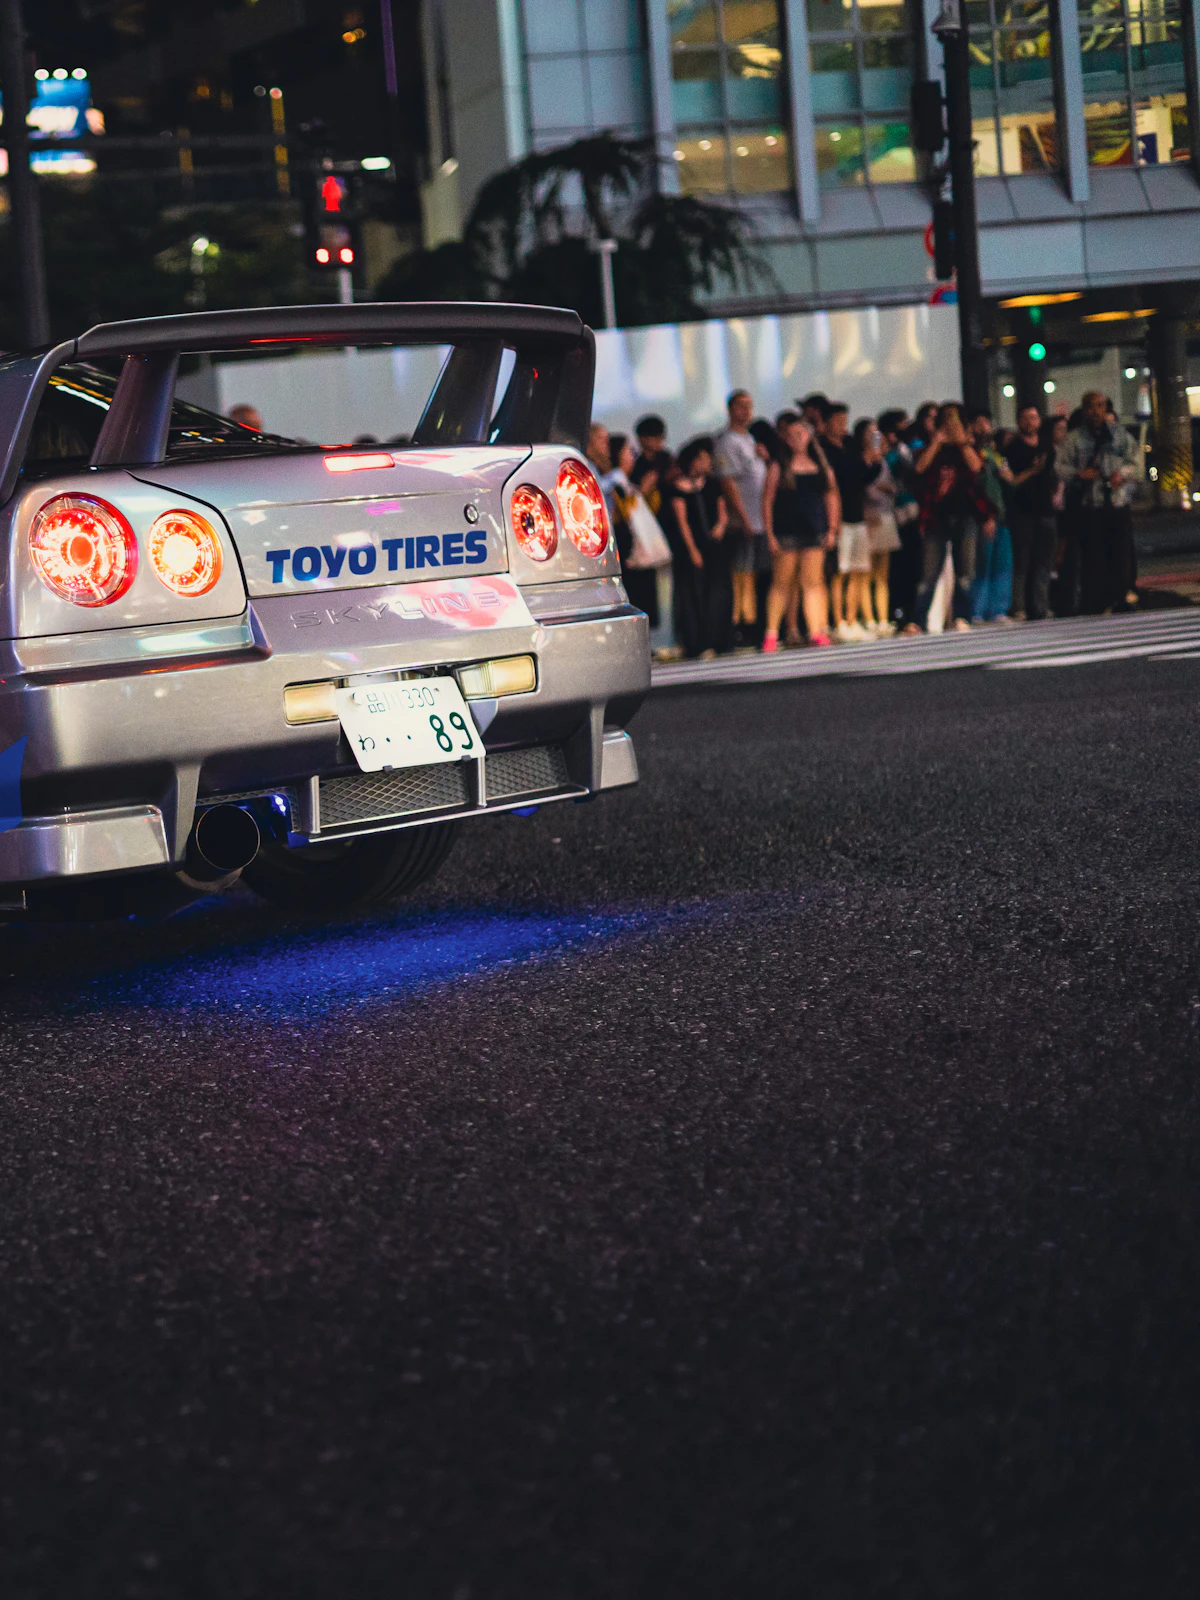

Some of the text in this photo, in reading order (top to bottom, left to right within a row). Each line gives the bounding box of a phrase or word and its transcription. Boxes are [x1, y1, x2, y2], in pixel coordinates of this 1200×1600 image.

[266, 531, 487, 584] TOYO TIRES
[290, 591, 501, 629] SKYLINE
